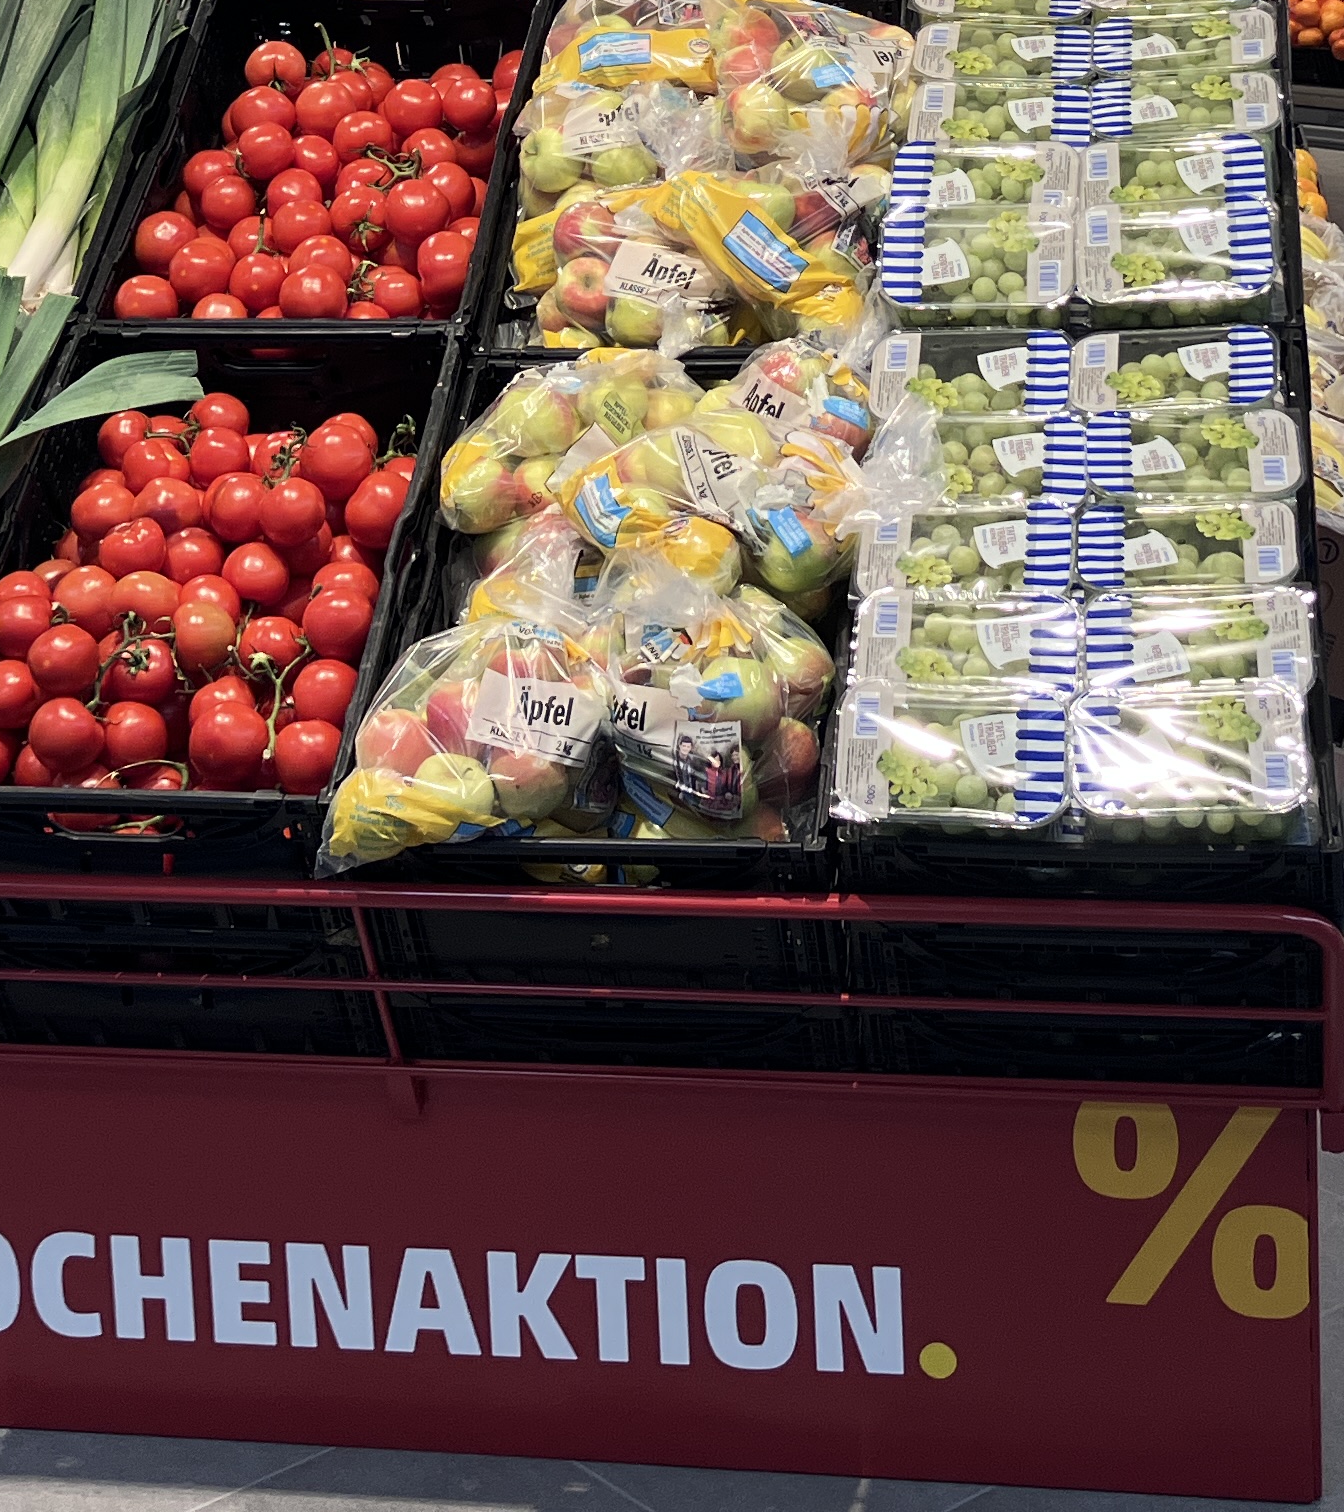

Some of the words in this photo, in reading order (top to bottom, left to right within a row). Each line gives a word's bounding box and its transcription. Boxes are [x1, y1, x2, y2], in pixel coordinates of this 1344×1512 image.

[641, 252, 697, 290] Äpfel
[644, 641, 660, 661] ENN
[864, 784, 877, 806] 500g
